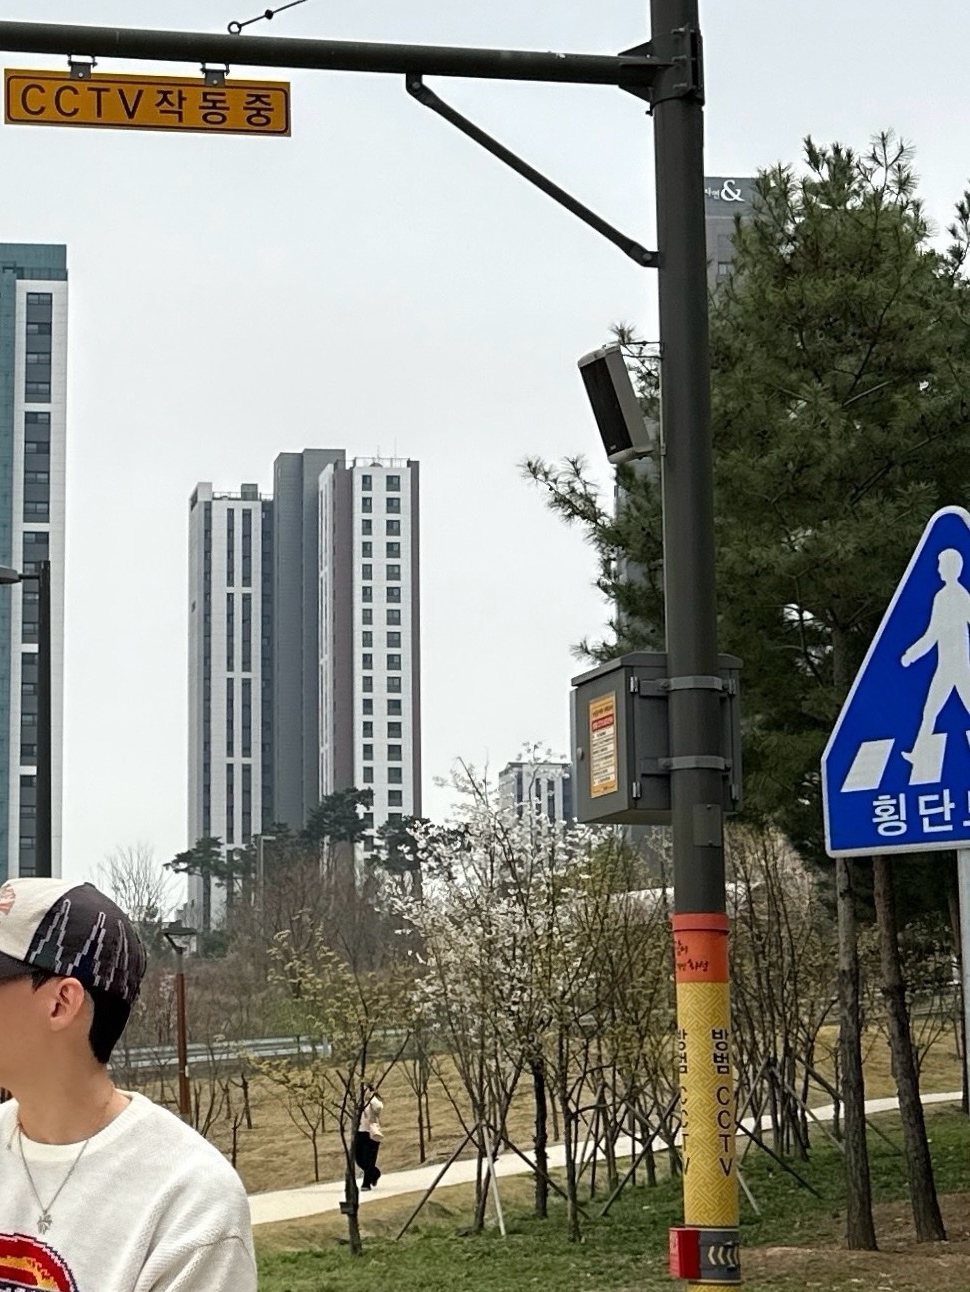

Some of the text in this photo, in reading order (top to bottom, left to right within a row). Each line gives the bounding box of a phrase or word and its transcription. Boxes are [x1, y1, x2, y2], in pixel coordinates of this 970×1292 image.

[872, 789, 970, 836] 횡단
[711, 1029, 733, 1177] 방범 CCTV
